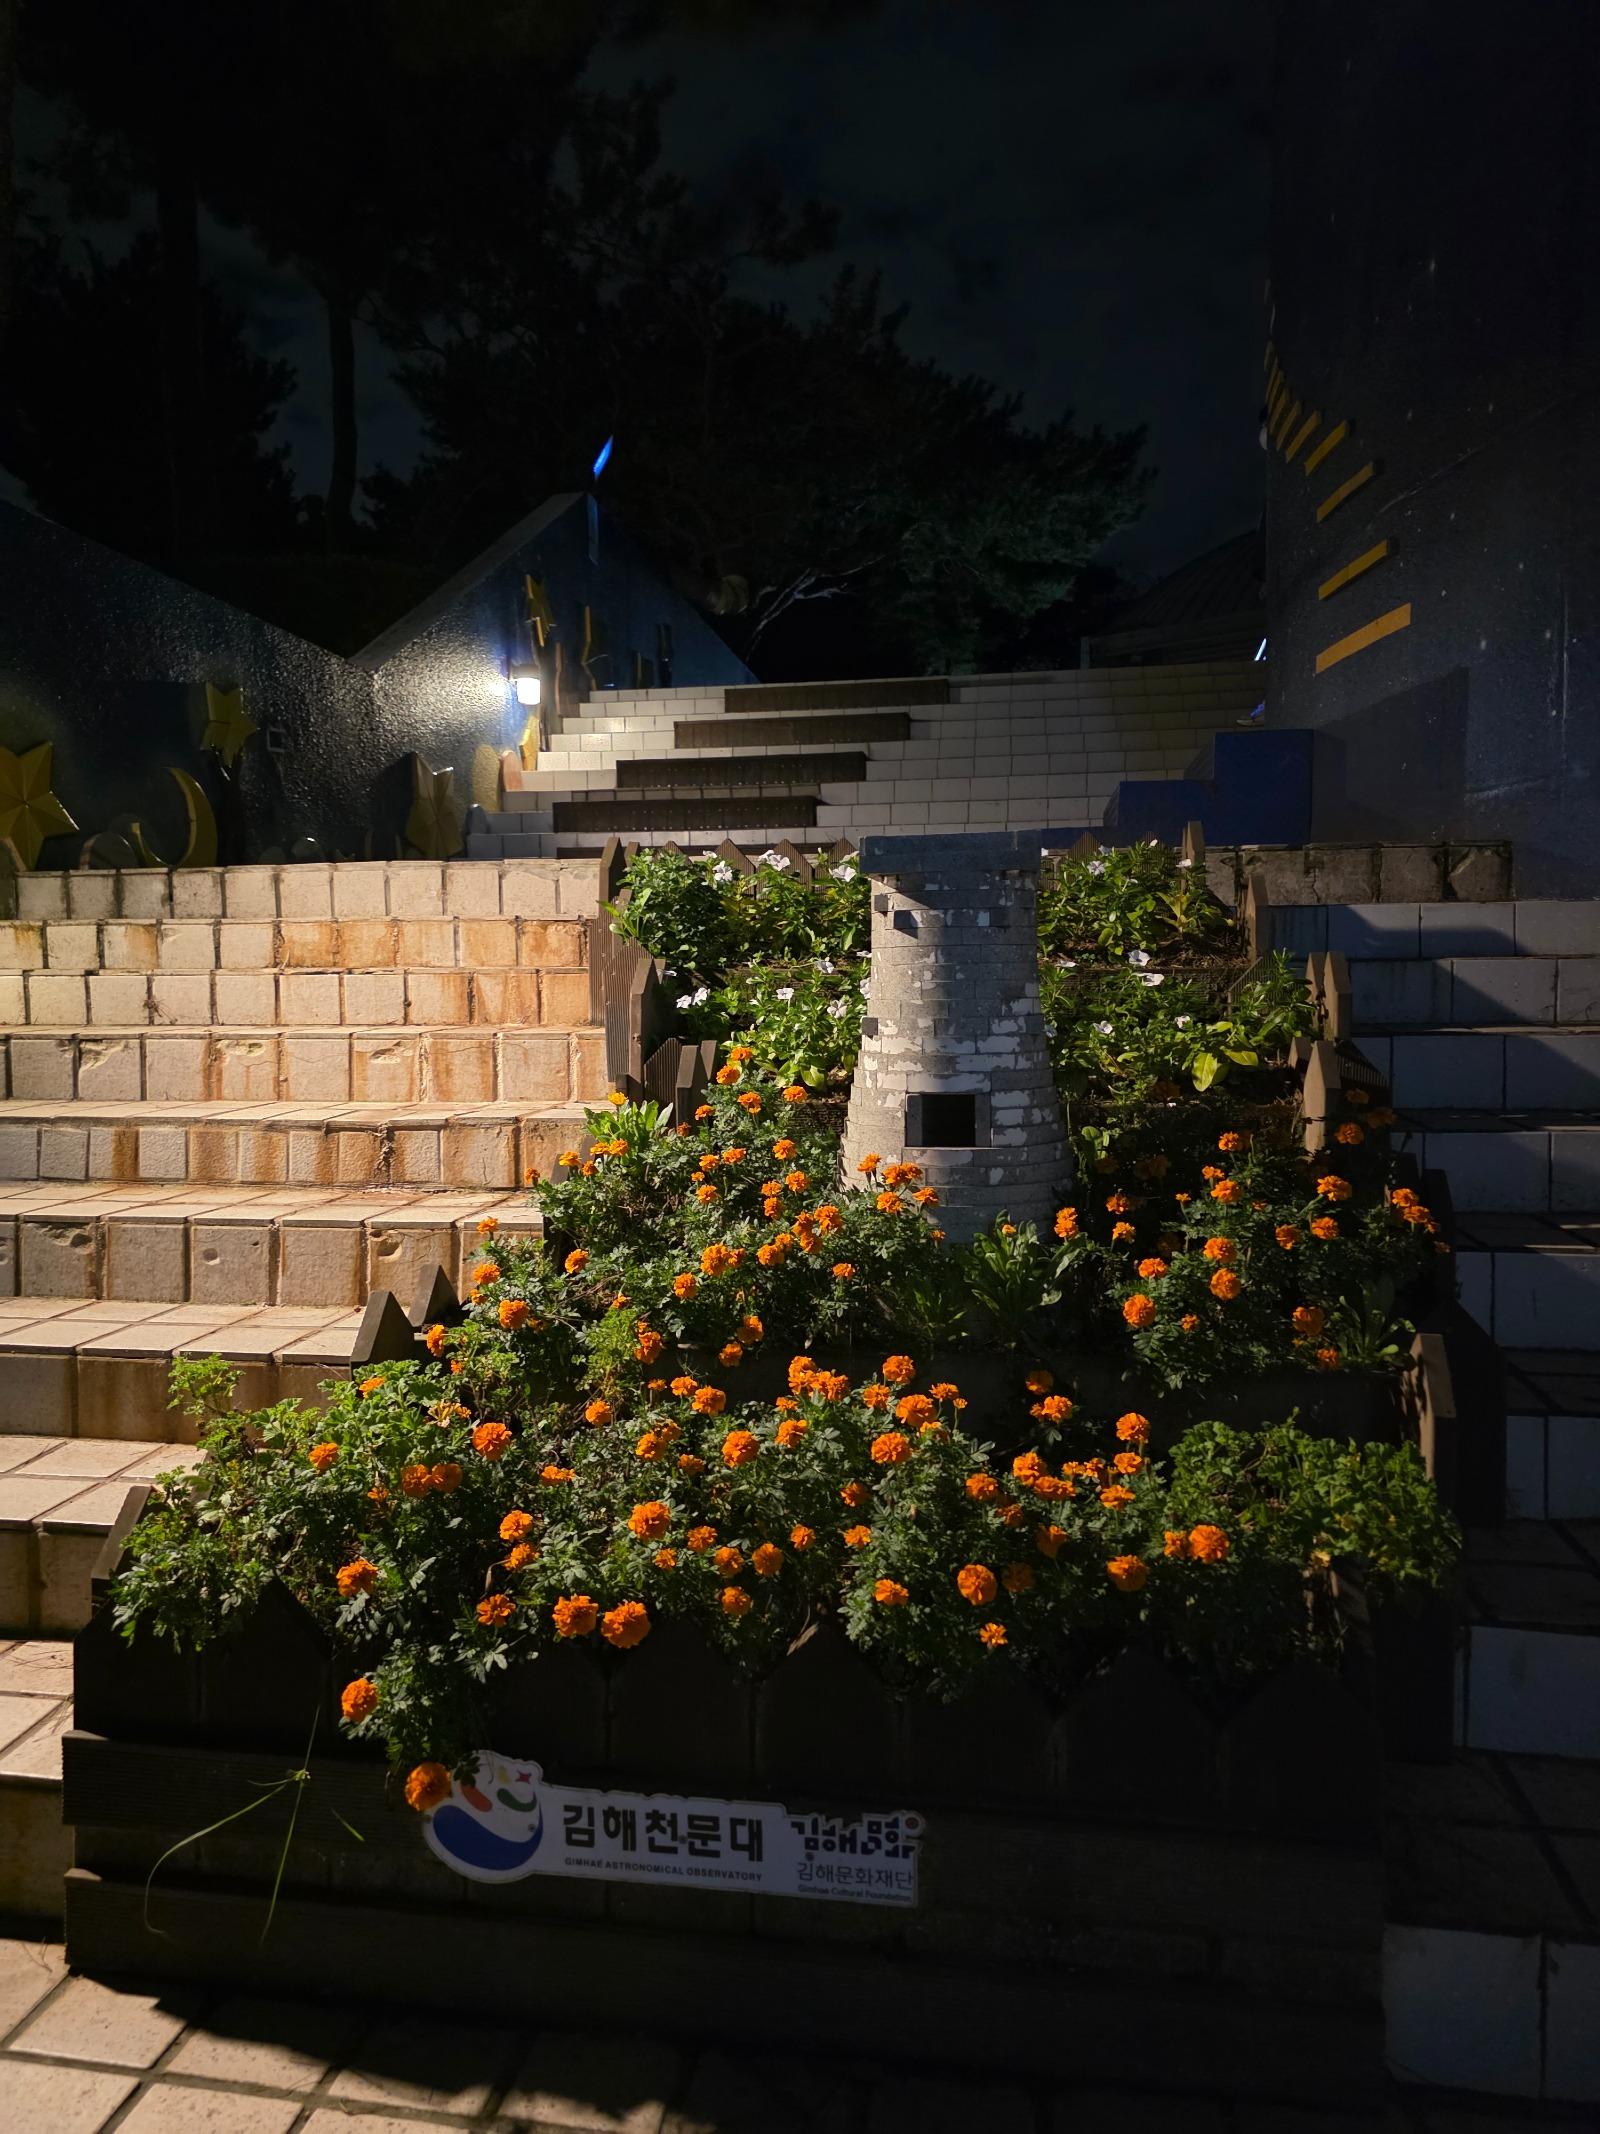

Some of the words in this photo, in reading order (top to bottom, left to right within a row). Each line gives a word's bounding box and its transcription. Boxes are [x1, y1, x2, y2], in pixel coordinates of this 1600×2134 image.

[563, 1804, 763, 1862] 김해천문대
[564, 1856, 602, 1869] GIMHAE
[605, 1860, 684, 1875] ASTRONOMICAL
[686, 1866, 763, 1882] OBSERVATORY
[797, 1861, 914, 1891] 김해문화재단
[831, 1887, 863, 1897] Cultural
[865, 1890, 912, 1901] Foundation
